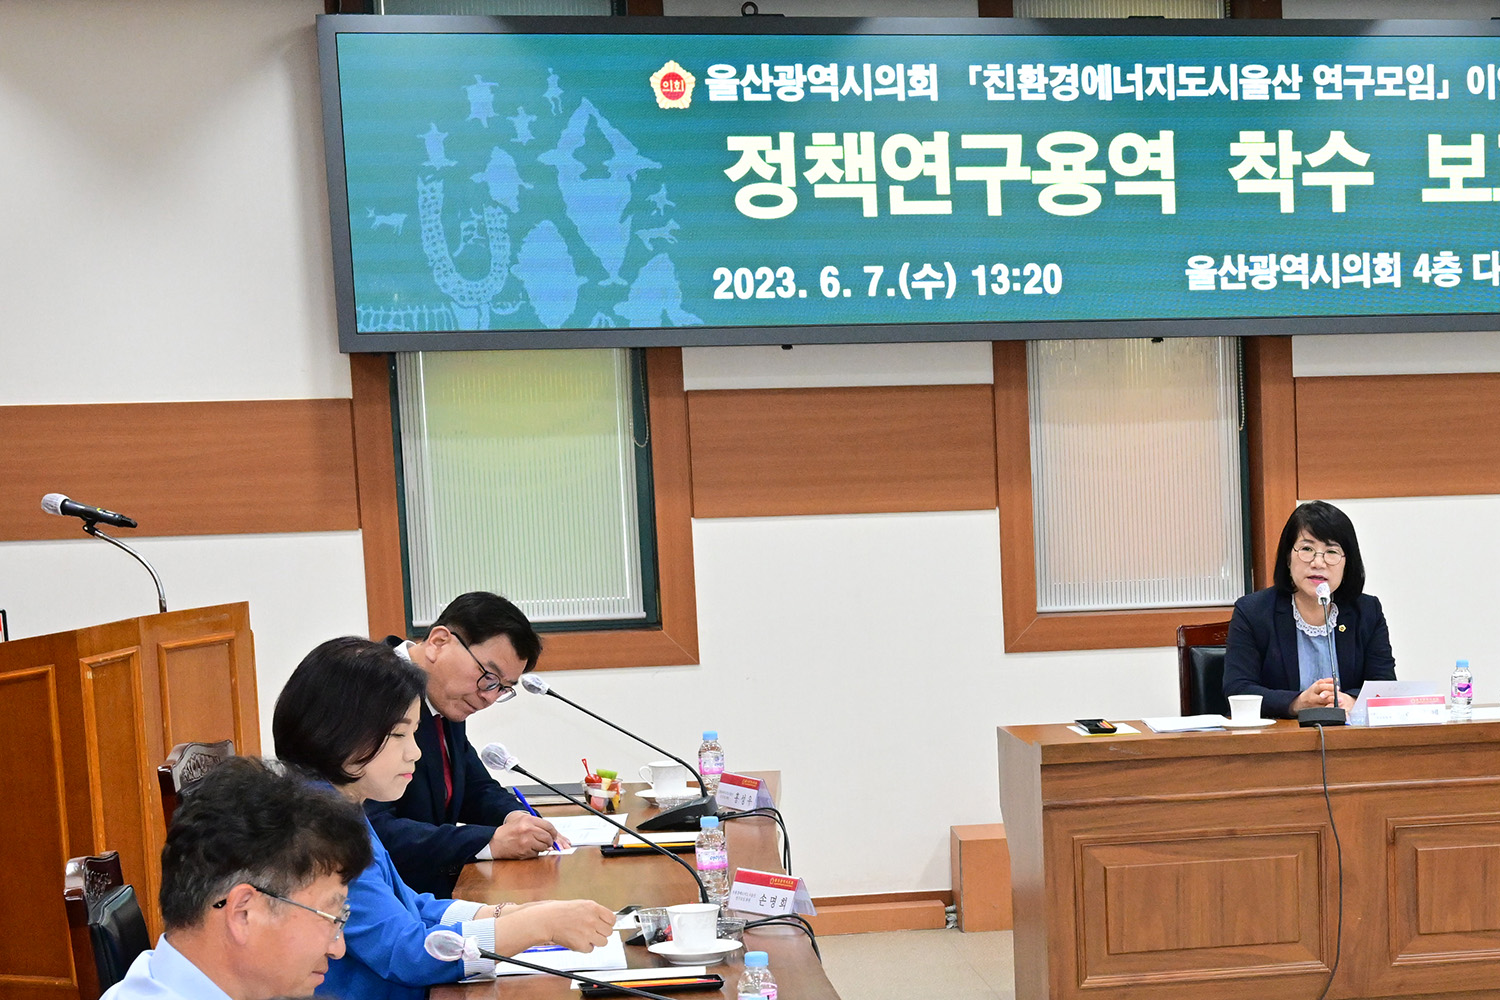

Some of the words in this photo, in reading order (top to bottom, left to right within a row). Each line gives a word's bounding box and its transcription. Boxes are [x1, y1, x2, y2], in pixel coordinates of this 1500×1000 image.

[662, 79, 685, 93] 의회
[705, 63, 939, 102] 울산광역시의회
[969, 63, 1303, 102] 「친환경에너지도시울산
[1314, 63, 1450, 101] 연구모임」
[723, 130, 1176, 220] 정책연구용역
[1228, 129, 1375, 214] 착수
[712, 266, 808, 300] 2023.
[819, 265, 852, 298] 6.
[863, 261, 957, 301] 7.(수)
[971, 262, 1063, 296] 13:20
[1185, 251, 1401, 291] 울산광역시의회
[1412, 250, 1463, 288] 4층
